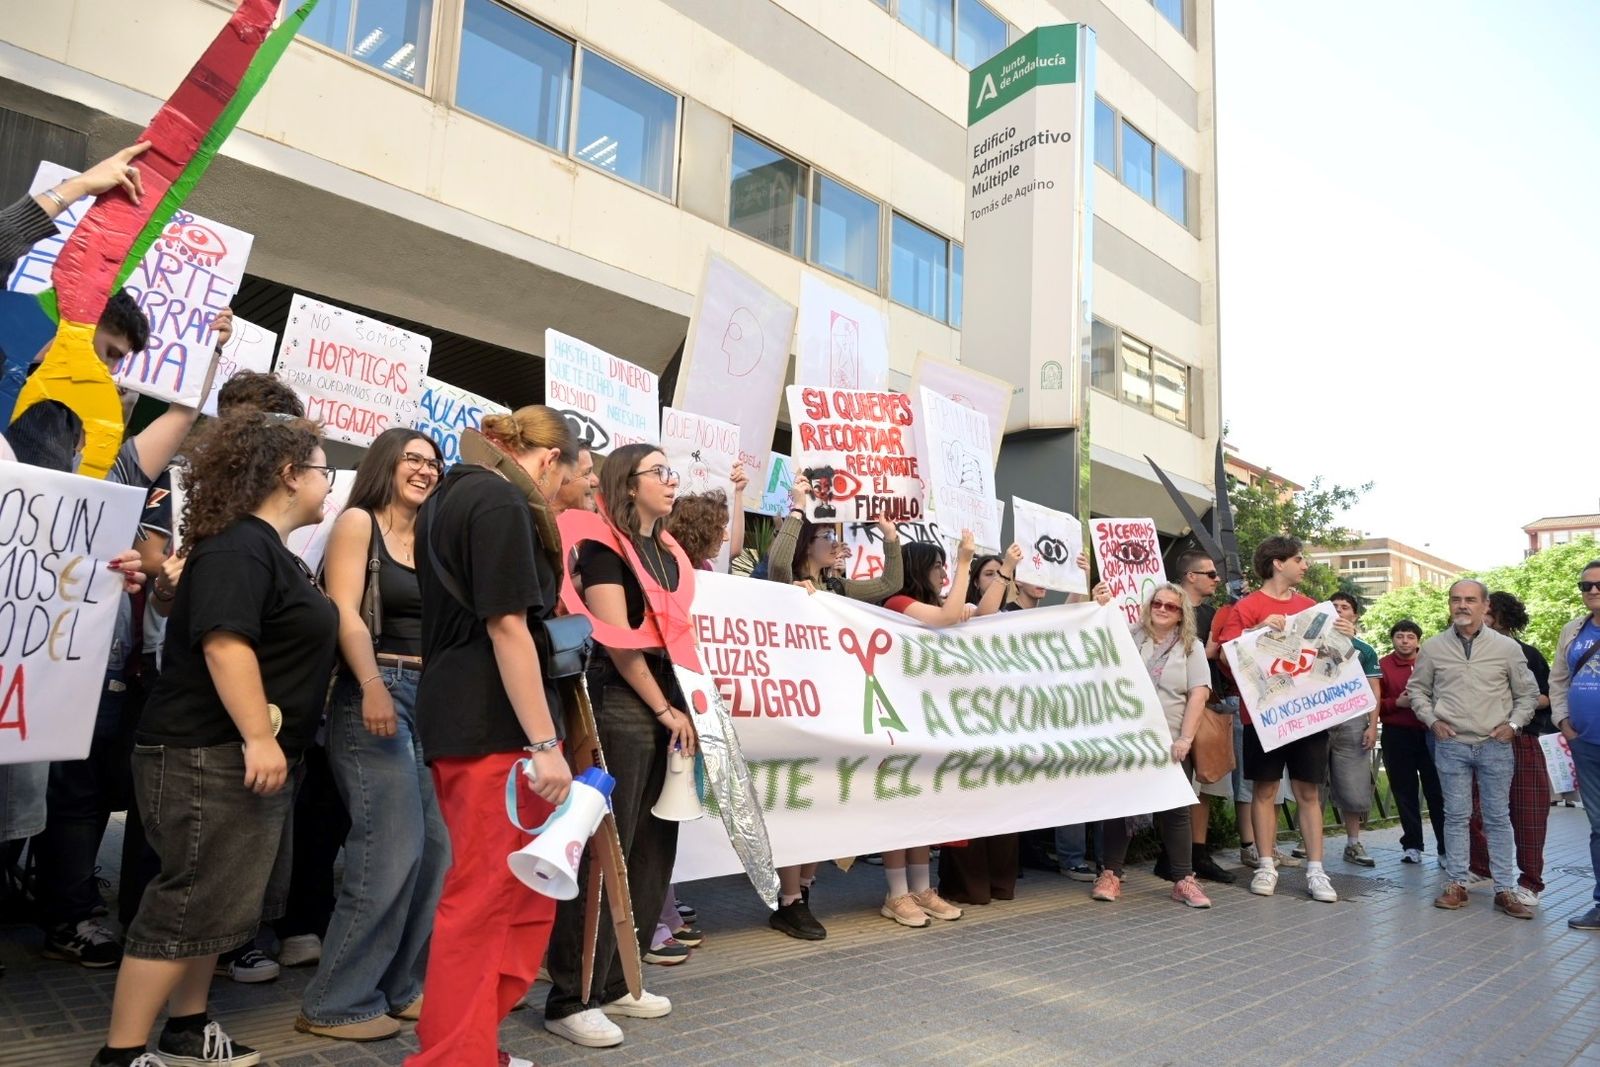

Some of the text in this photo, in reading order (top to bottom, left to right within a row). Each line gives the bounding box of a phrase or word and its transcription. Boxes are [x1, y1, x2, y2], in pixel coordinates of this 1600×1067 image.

[1000, 53, 1066, 89] de Andalucía
[1001, 54, 1026, 77] Junta
[972, 130, 1072, 178] Administrativo
[973, 126, 1016, 159] Edificio
[970, 178, 1055, 221] Tomás de Aquino
[972, 164, 1020, 198] Múltiple
[310, 313, 409, 352] NO SOMOS
[307, 338, 408, 394] HORMIGAS
[549, 357, 571, 381] QUE
[572, 367, 584, 388] TE
[553, 338, 651, 393] HASTA EL DINERO
[287, 368, 413, 413] PARA QUEDARNOS CON LAS
[550, 380, 596, 413] BOLSILLO
[801, 387, 831, 420] SI
[832, 390, 914, 426] QUIERES
[666, 412, 737, 455] QUE NO NOS
[799, 422, 905, 455] RECORTAR
[873, 475, 894, 494] EL
[50, 496, 106, 555] UN
[1096, 522, 1114, 540] SI
[753, 619, 781, 648] DE
[784, 623, 832, 651] ARTE
[896, 626, 1121, 678] DESMANTELAN
[920, 677, 1145, 738] A ESCONDIDAS
[1260, 707, 1278, 728] NO
[1278, 698, 1301, 720] NOS
[1302, 678, 1362, 711] ENCONTRAMOS
[1277, 718, 1305, 739] ENTRE
[836, 755, 868, 803] Y
[874, 753, 923, 802] EL
[932, 728, 1171, 793] PENSAMIENTO
